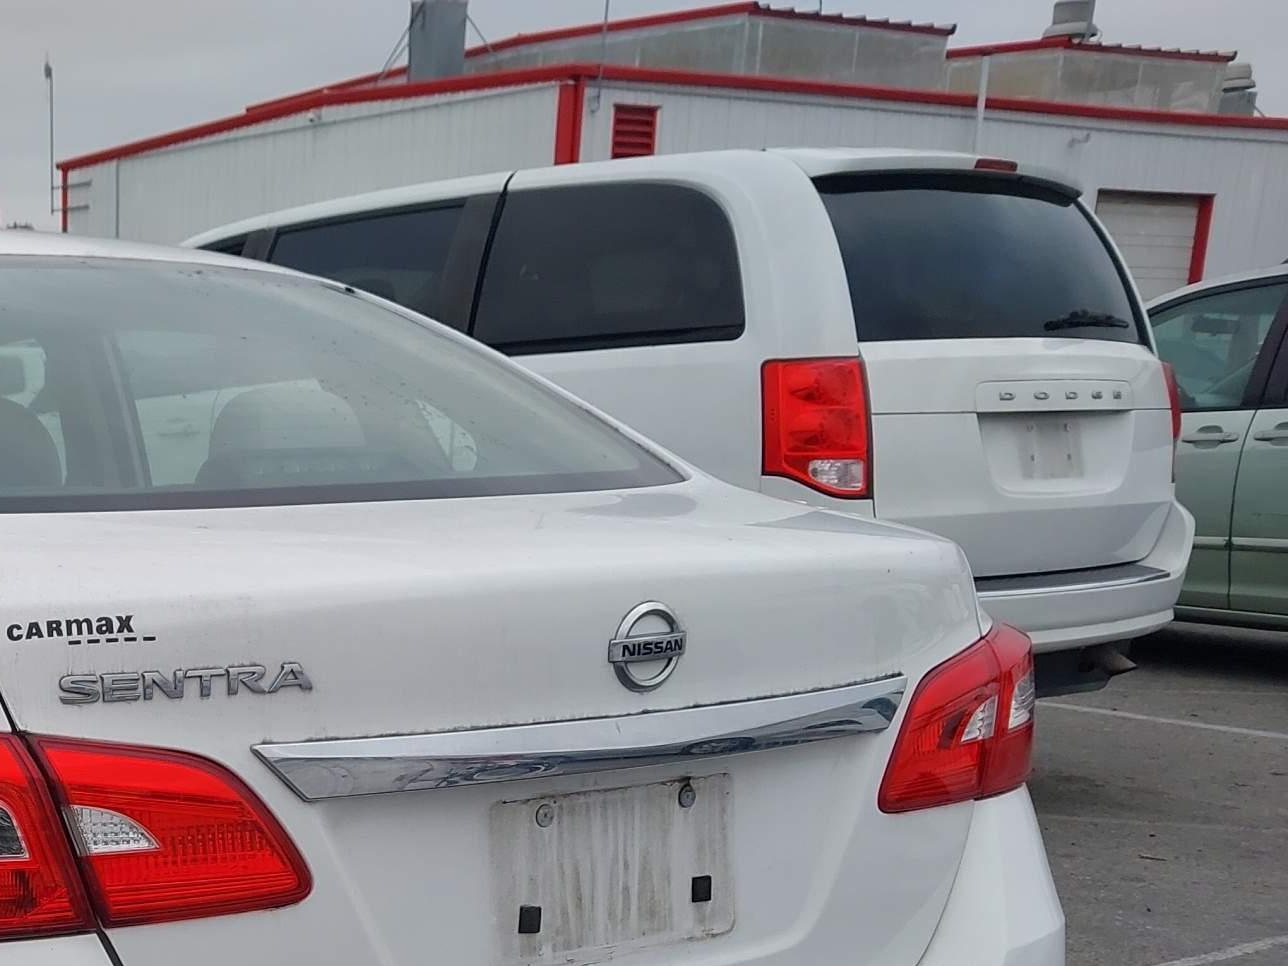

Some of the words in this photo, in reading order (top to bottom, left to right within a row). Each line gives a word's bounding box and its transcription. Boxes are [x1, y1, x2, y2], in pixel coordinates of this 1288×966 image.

[999, 391, 1122, 401] DODGE
[621, 638, 683, 657] NISSAN
[58, 662, 313, 704] SENTRA
